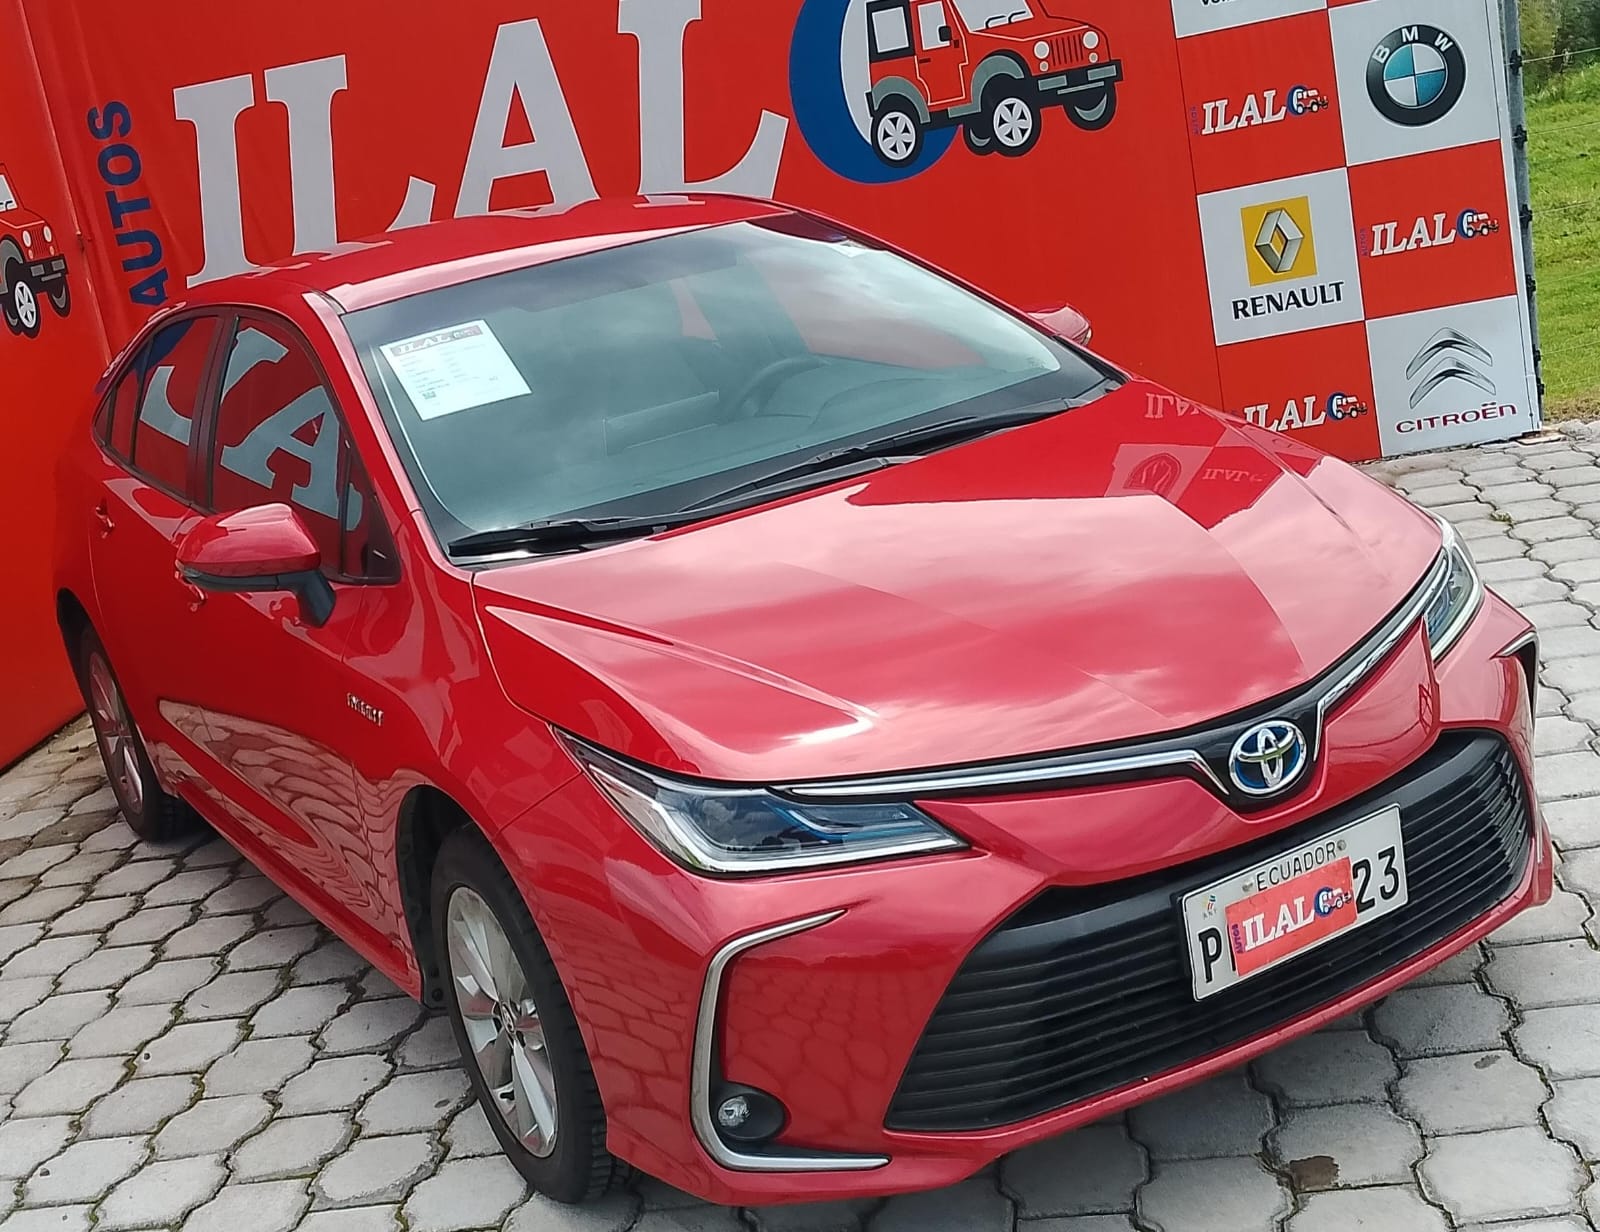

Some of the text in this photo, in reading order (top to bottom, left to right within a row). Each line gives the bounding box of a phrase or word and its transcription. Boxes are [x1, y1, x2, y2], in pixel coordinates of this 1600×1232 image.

[1372, 26, 1453, 63] BMW
[87, 101, 169, 306] AUTOS
[1231, 281, 1345, 320] RENAULT
[1256, 840, 1337, 892] ECUADOR
